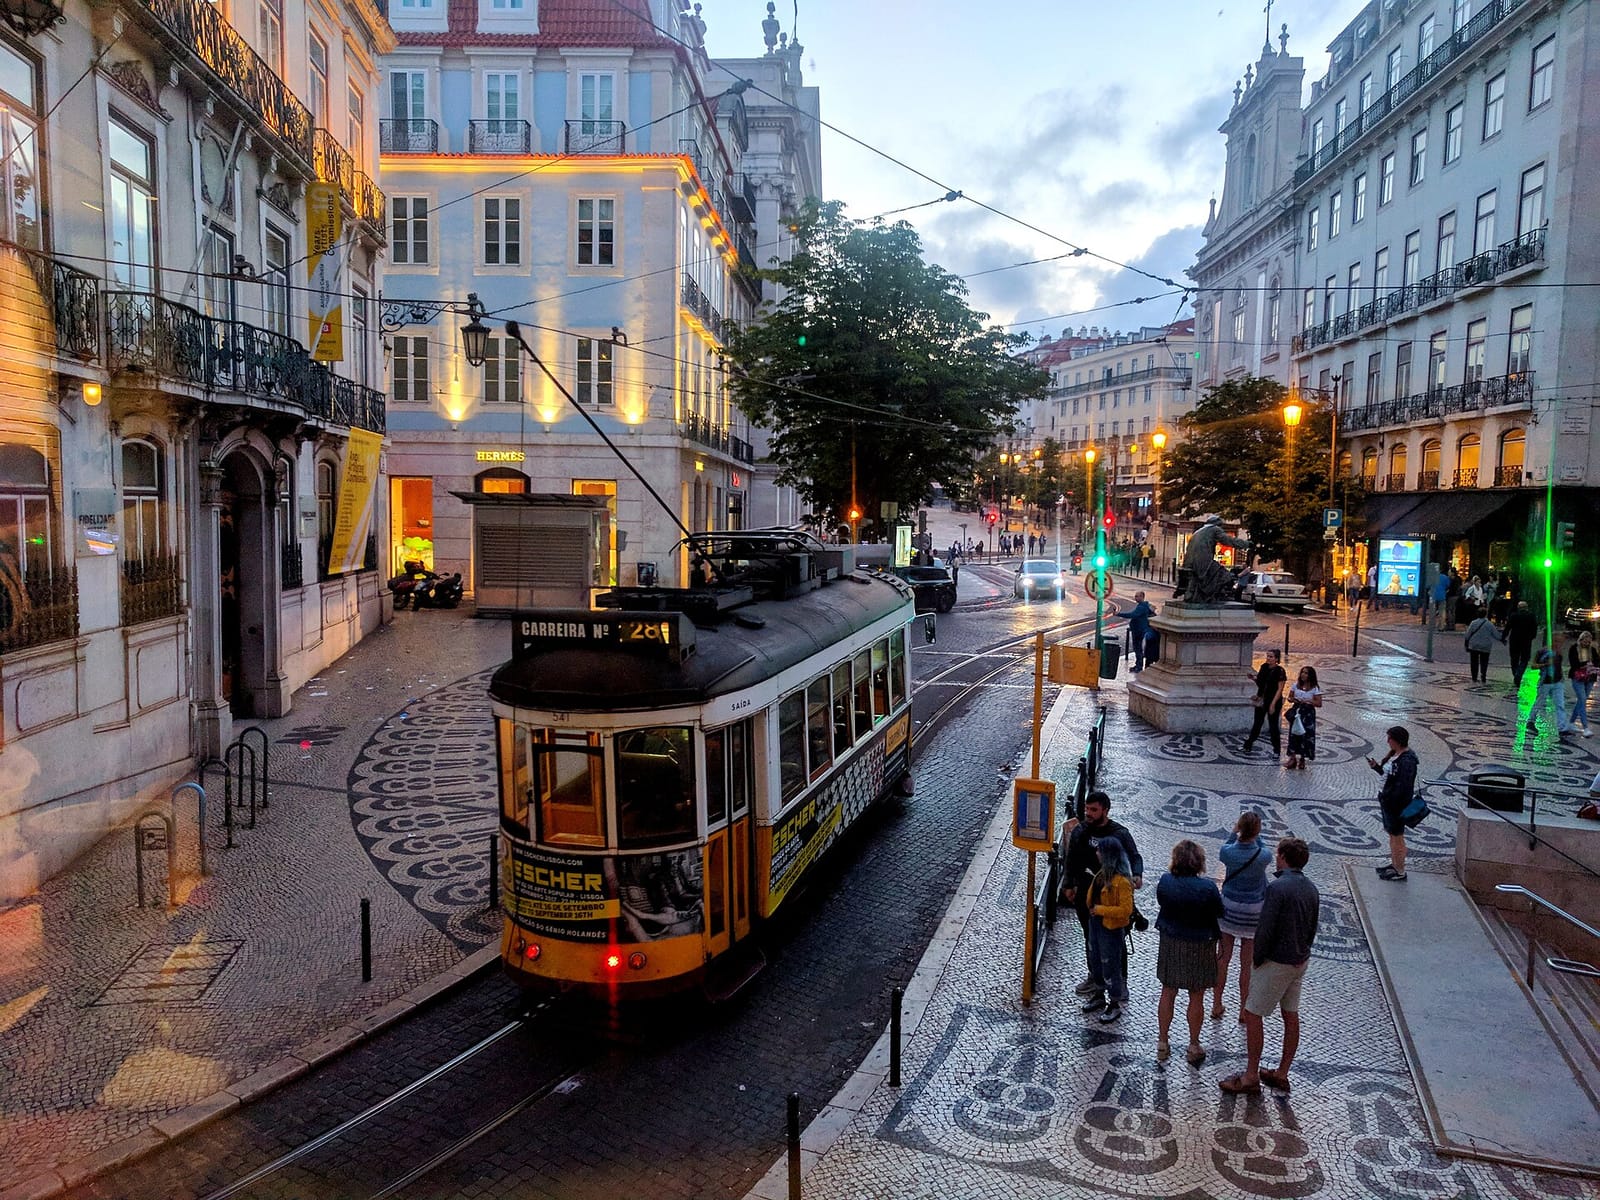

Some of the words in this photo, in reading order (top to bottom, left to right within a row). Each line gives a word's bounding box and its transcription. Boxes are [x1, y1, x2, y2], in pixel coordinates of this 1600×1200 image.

[327, 194, 336, 257] Commissions
[320, 223, 328, 256] Artists
[1327, 510, 1339, 525] P
[521, 621, 586, 638] CARREIRA
[731, 699, 751, 711] SAÍDA
[552, 712, 570, 722] 541
[771, 799, 816, 856] ESCHER
[514, 860, 602, 892] ESCHER
[580, 893, 605, 901] LISBOA
[535, 909, 573, 919] SEPTEMBER
[562, 903, 605, 912] SETEMBRO
[566, 929, 607, 939] HOLANDÊS
